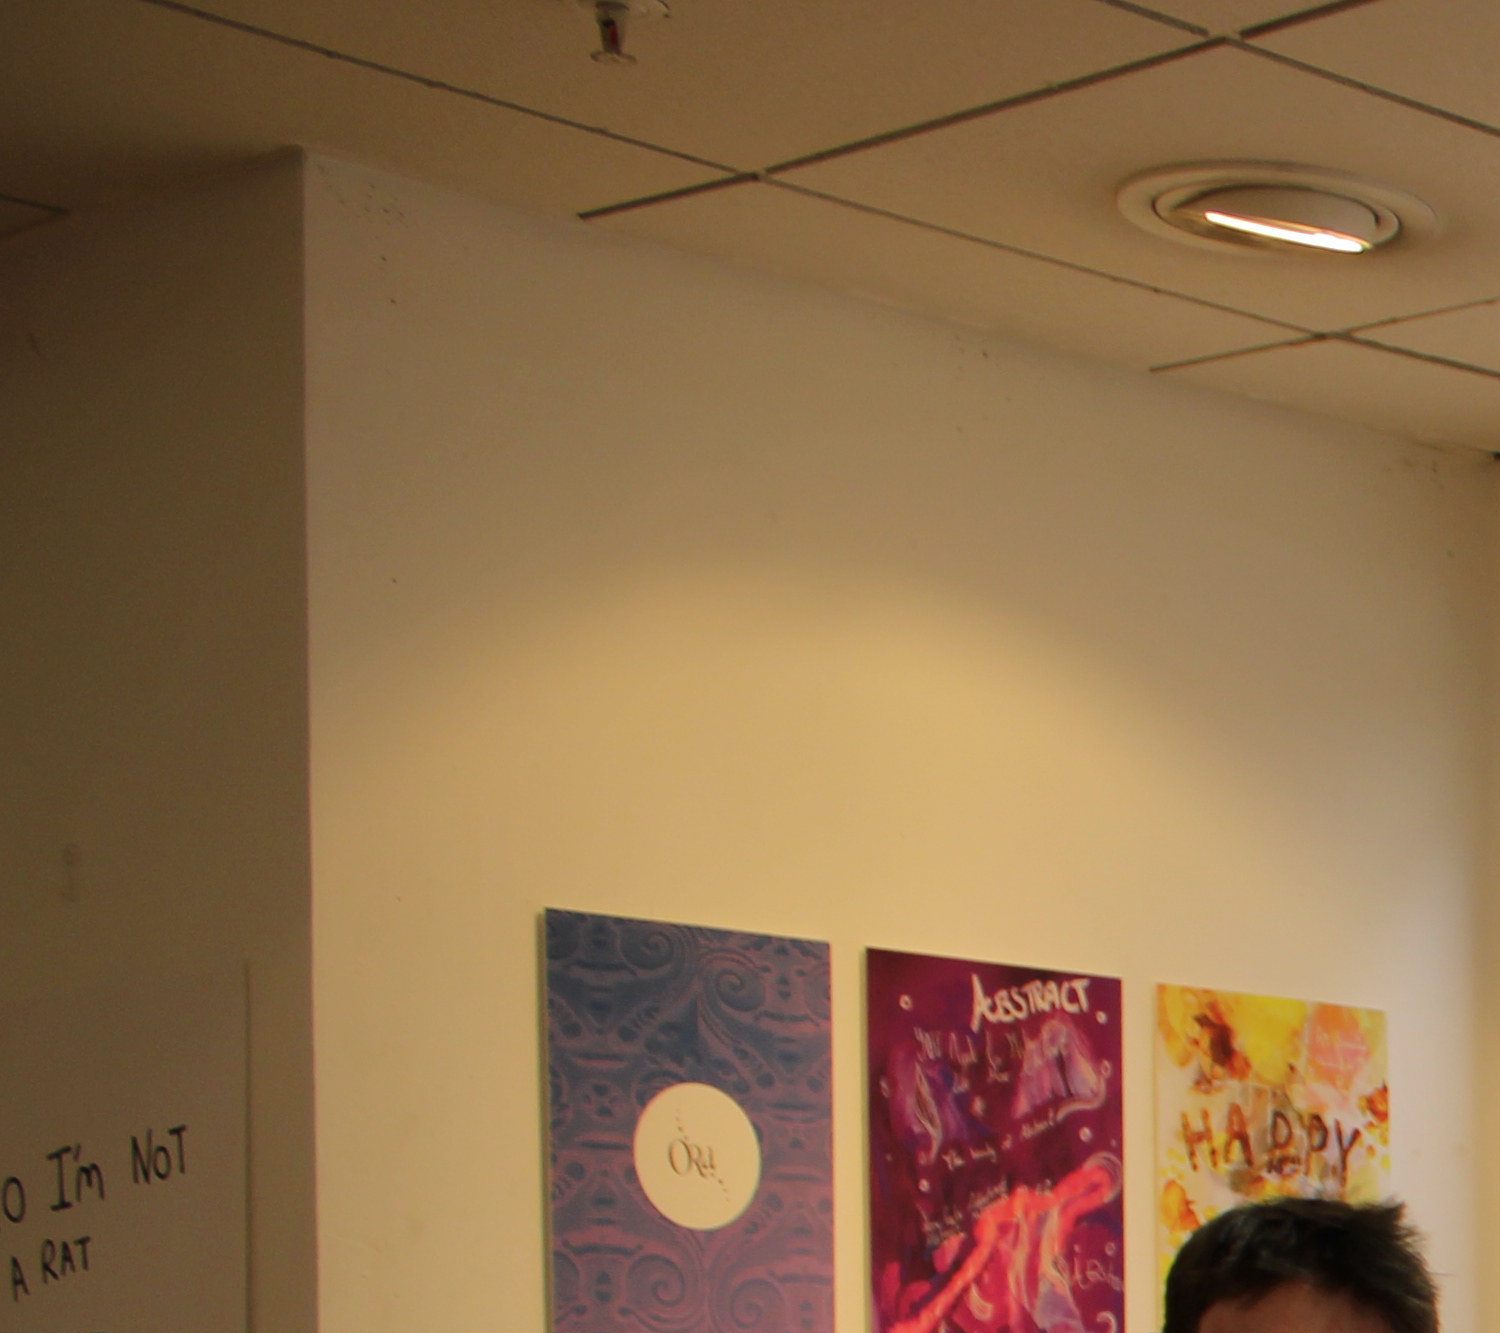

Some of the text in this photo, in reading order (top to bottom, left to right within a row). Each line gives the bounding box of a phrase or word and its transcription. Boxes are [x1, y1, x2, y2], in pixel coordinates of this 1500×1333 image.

[1180, 1101, 1361, 1188] HAPPY
[10, 1236, 92, 1303] A RAT
